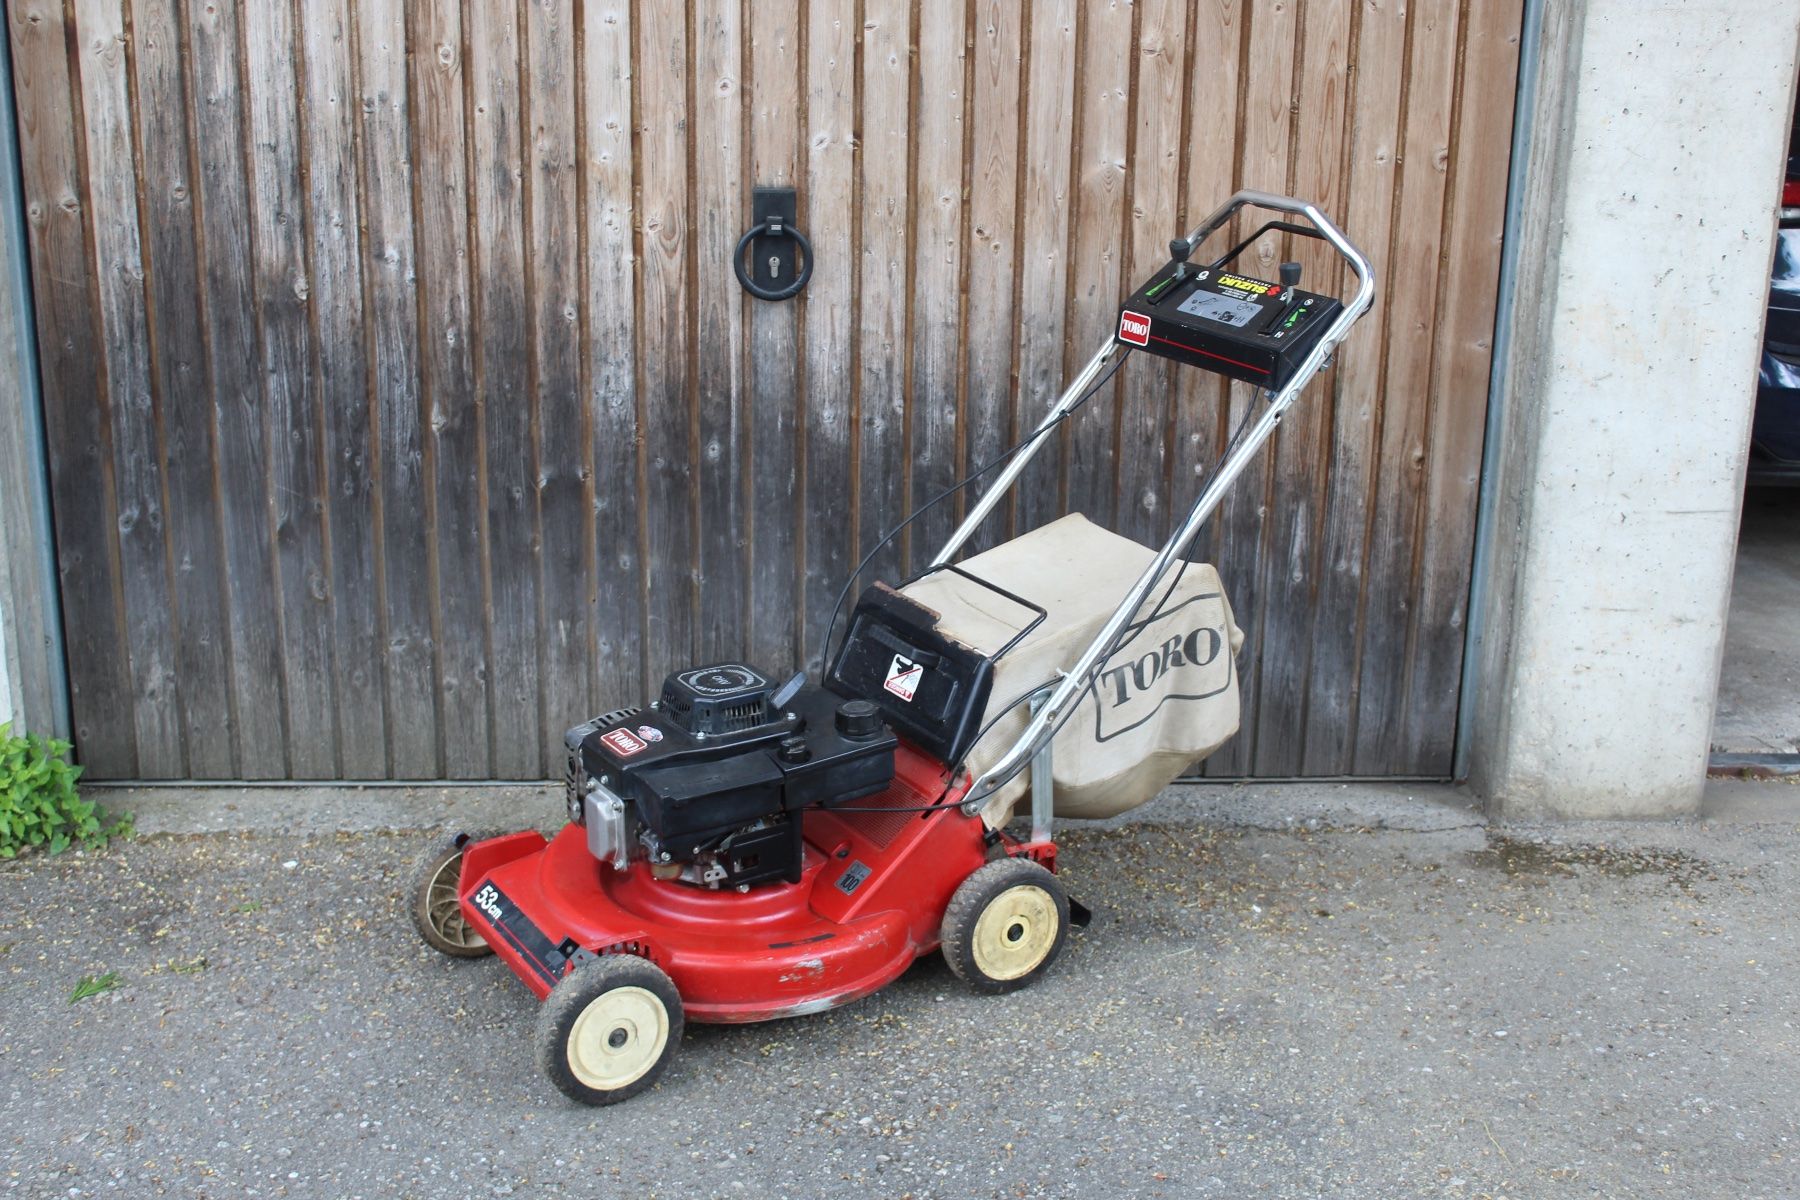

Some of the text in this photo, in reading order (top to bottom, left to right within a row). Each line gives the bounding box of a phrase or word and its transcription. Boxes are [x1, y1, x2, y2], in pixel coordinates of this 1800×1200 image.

[1217, 276, 1269, 294] SUZUKI
[1123, 319, 1147, 336] TORO
[1101, 627, 1221, 708] TORO
[609, 731, 640, 751] TORO
